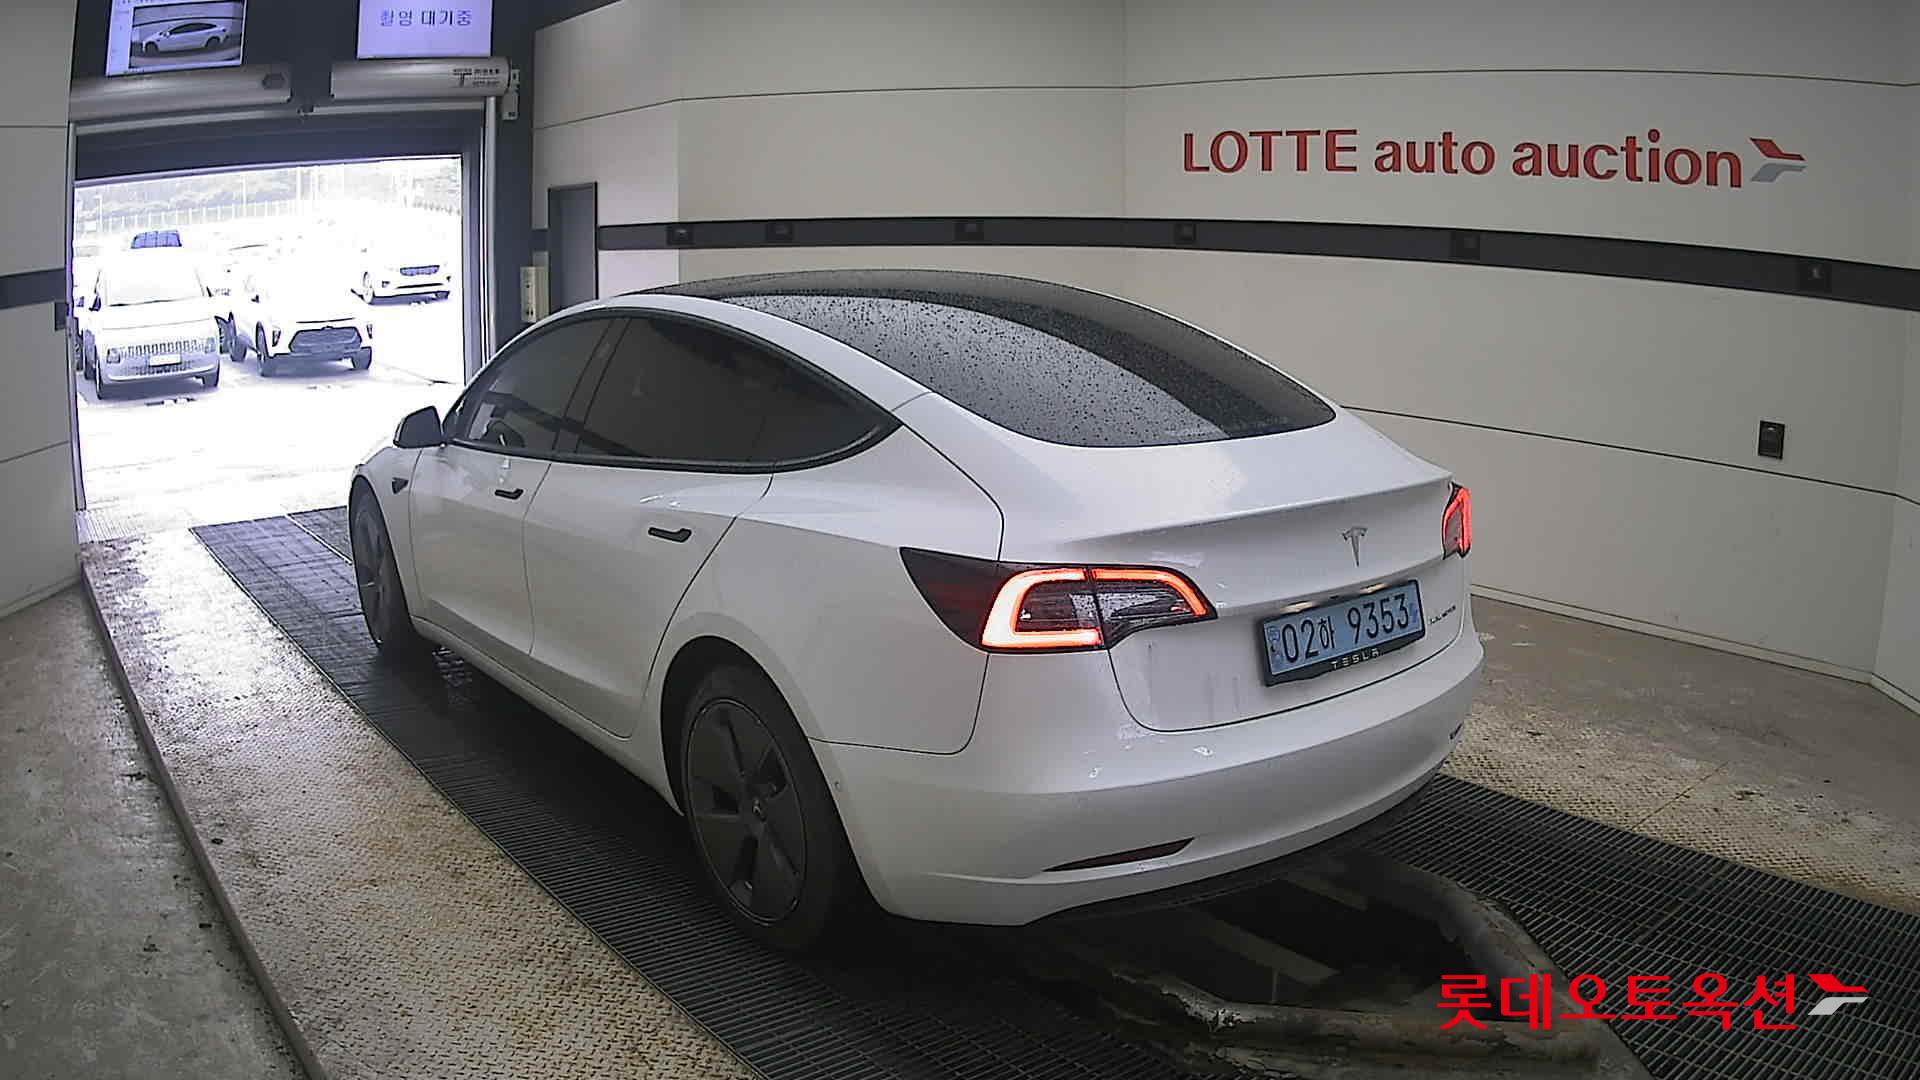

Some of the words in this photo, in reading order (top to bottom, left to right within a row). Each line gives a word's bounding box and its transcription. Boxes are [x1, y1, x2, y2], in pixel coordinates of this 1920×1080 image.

[421, 9, 472, 26] 대기중
[1183, 129, 1358, 173] LOTTE
[1374, 131, 1496, 176] auto
[1511, 129, 1743, 189] auction
[1281, 615, 1337, 664] 02하
[1347, 593, 1410, 645] 9353
[1330, 648, 1383, 670] TESLA
